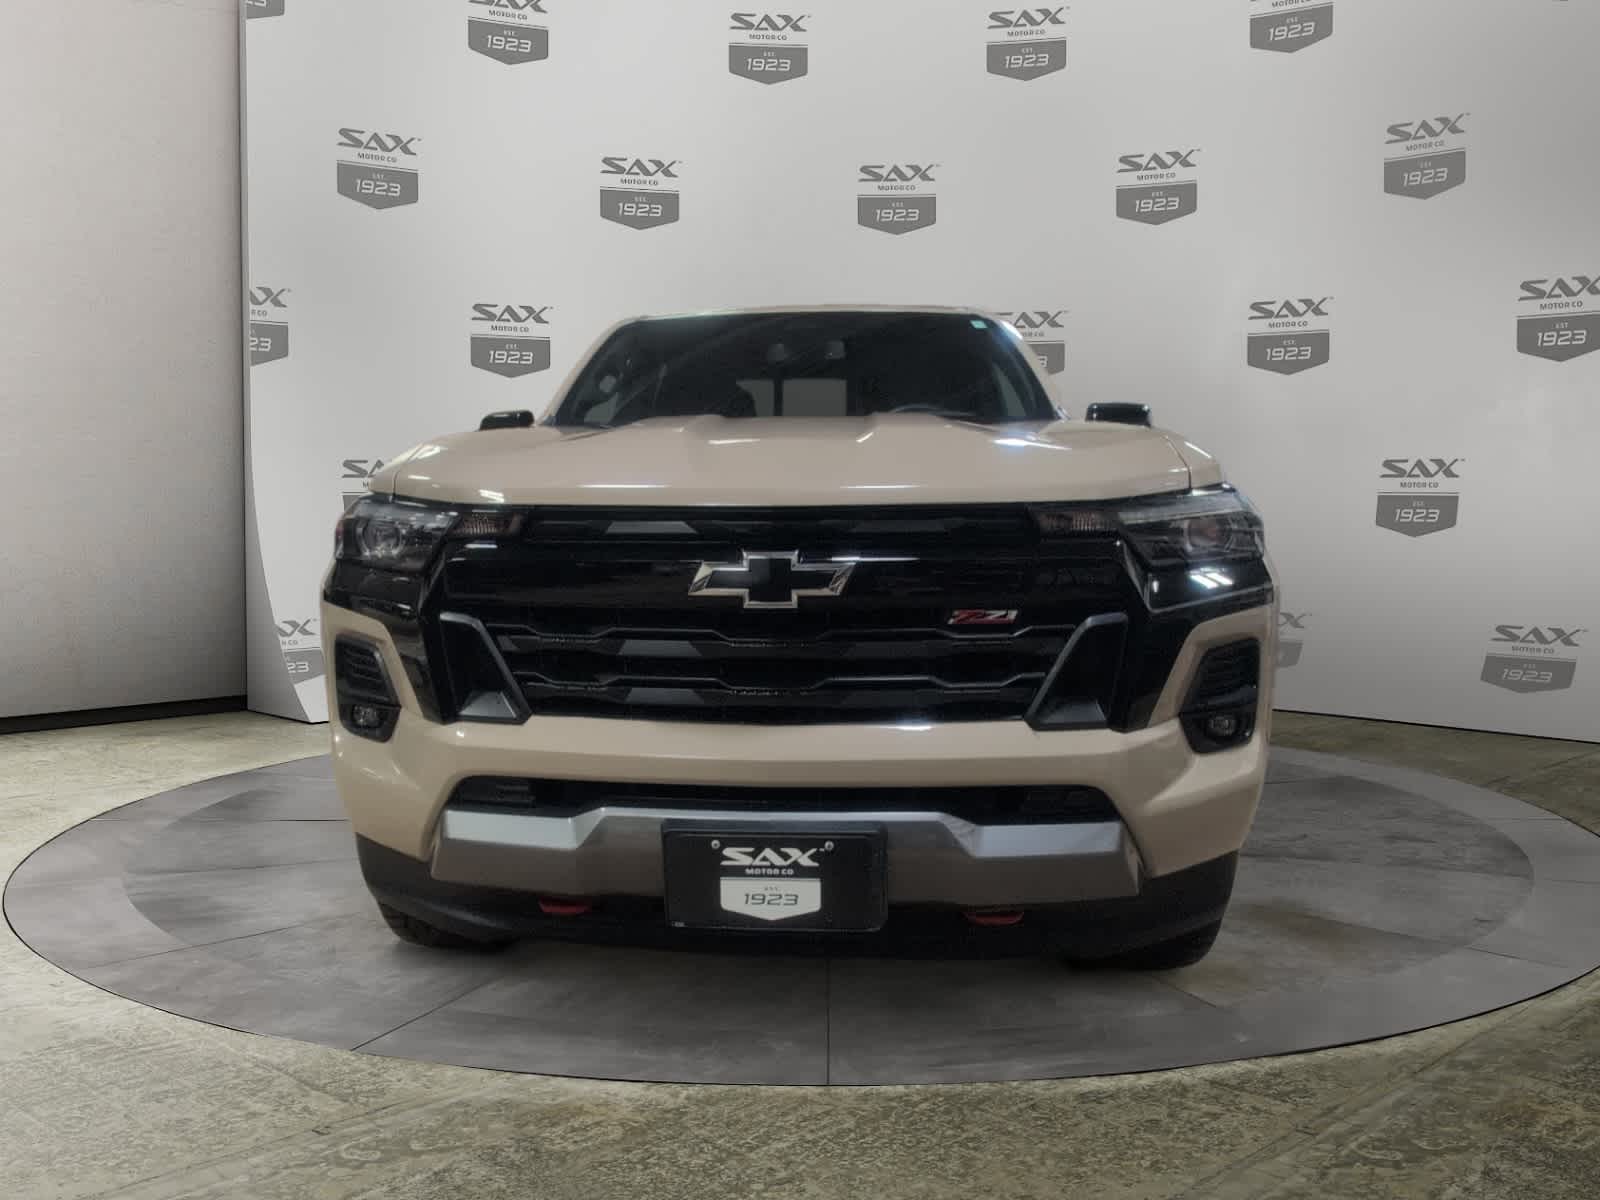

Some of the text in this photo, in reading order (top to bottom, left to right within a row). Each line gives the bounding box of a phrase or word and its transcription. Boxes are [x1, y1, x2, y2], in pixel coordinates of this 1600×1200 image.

[730, 13, 807, 32] SAX
[987, 7, 1066, 29] SAX
[1270, 22, 1315, 40] 1923
[488, 35, 532, 52] 1923
[747, 58, 791, 71] 1923
[1006, 54, 1048, 68] 1923
[1384, 112, 1464, 144] SAX
[337, 128, 416, 155] SAX
[600, 157, 678, 177] SAX
[1116, 149, 1196, 173] SAX
[858, 164, 935, 182] SAX
[1403, 167, 1448, 186] 1923
[356, 178, 400, 196] 1923
[618, 202, 662, 216] 1923
[1136, 197, 1180, 212] 1923
[876, 208, 920, 222] 1923
[1518, 276, 1600, 301] SAX
[472, 304, 549, 324] SAX
[1248, 297, 1328, 320] SAX
[250, 337, 272, 352] 23
[1537, 330, 1587, 346] 1923
[489, 350, 533, 364] 1923
[1266, 346, 1312, 360] 1923
[1380, 459, 1459, 478] SAX
[1395, 508, 1440, 522] 1923
[1491, 625, 1579, 647] SAX
[287, 661, 310, 673] 23
[1503, 668, 1552, 682] 1923
[720, 847, 820, 867] SAX
[744, 893, 799, 906] 1923
